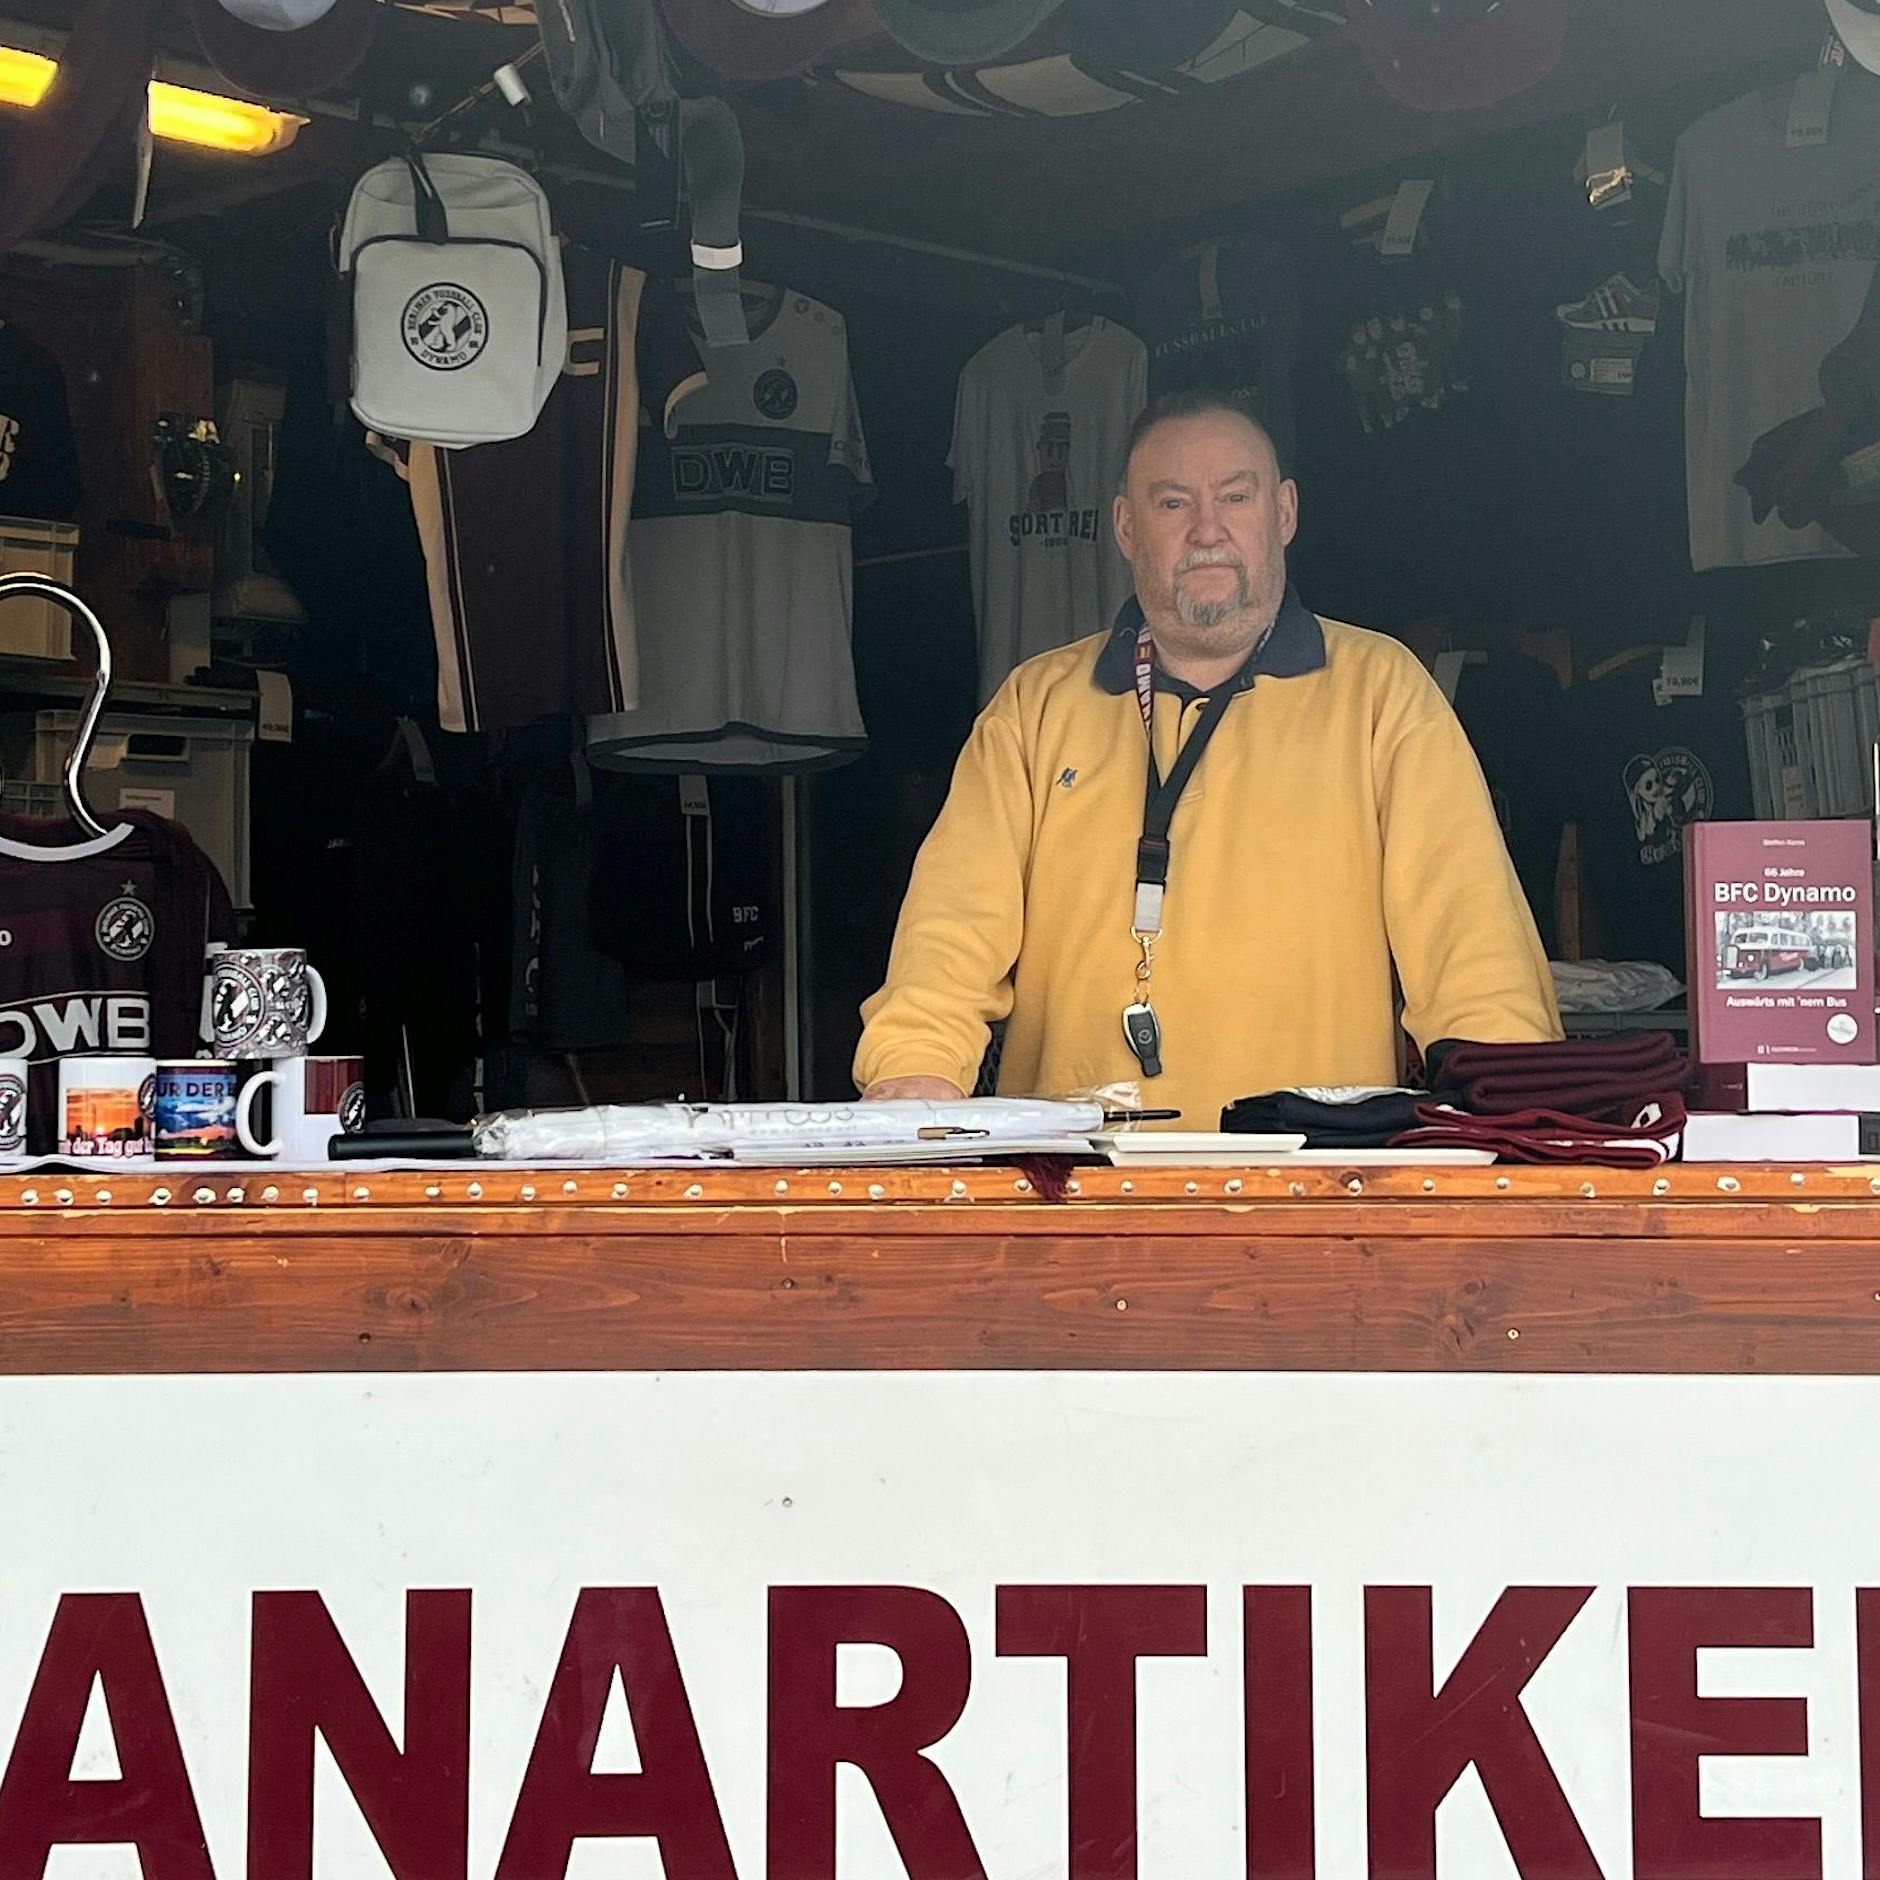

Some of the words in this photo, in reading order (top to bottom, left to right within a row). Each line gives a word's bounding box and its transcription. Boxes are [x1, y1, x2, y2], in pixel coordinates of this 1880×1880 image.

[674, 448, 792, 496] DWB
[1714, 882, 1759, 903] BFC
[1764, 882, 1857, 907] Dynamo
[732, 906, 759, 923] BFC
[1826, 995, 1847, 1008] Bus
[72, 1137, 94, 1154] der
[96, 1137, 122, 1157] Tag
[0, 1585, 1880, 1880] ANARTIKE
